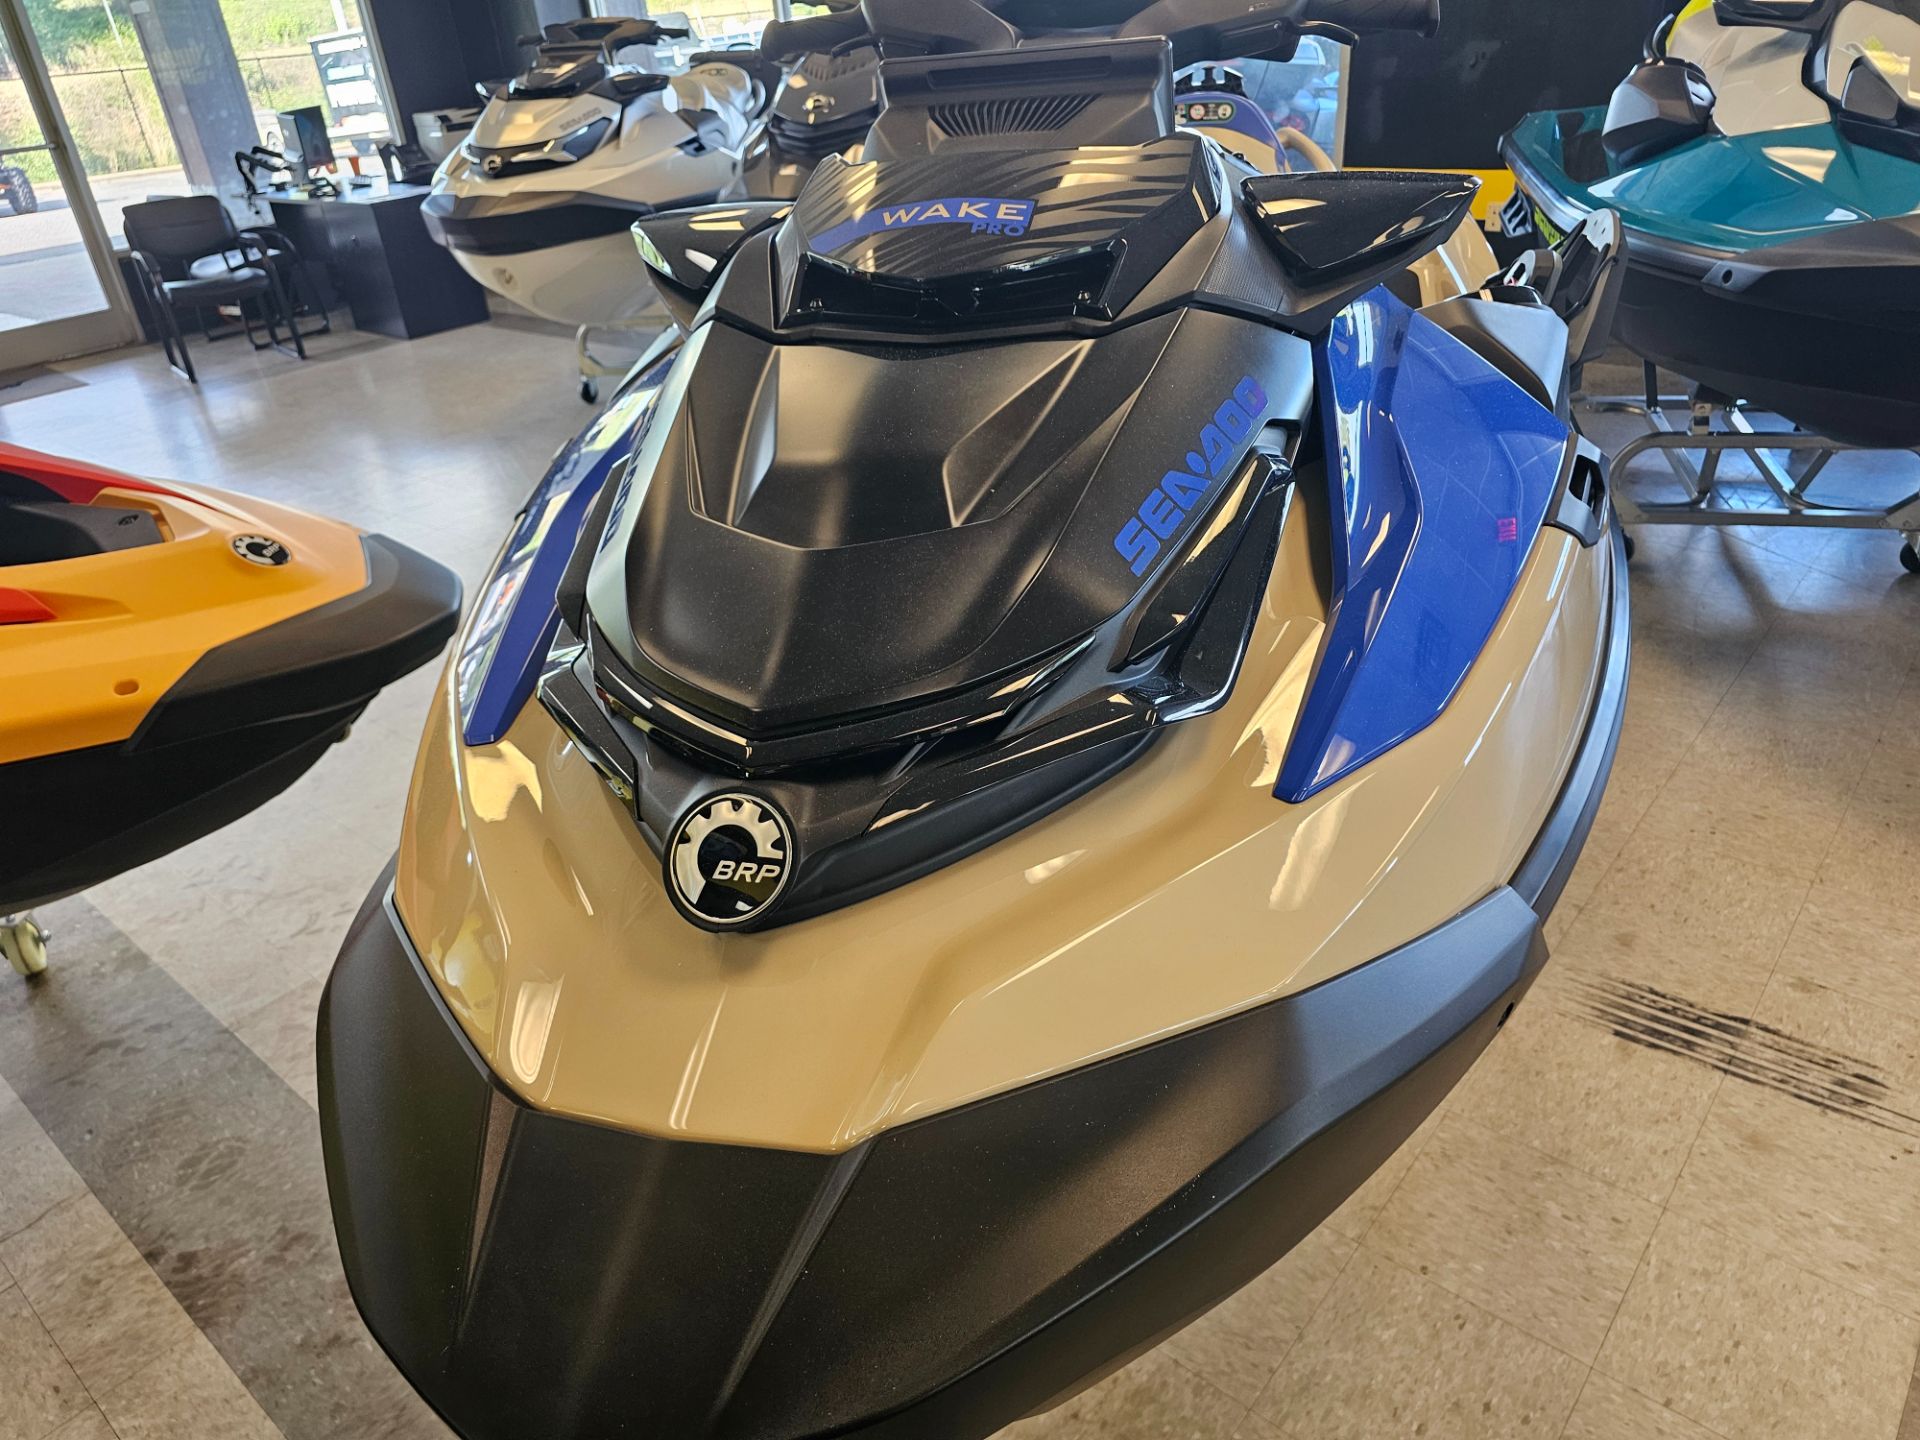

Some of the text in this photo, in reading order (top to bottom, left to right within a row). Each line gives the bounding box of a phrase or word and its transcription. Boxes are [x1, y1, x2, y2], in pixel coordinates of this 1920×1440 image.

[882, 202, 1027, 225] WAKE
[970, 222, 1024, 237] PRO
[262, 542, 280, 557] BRP
[711, 859, 781, 883] BRP
